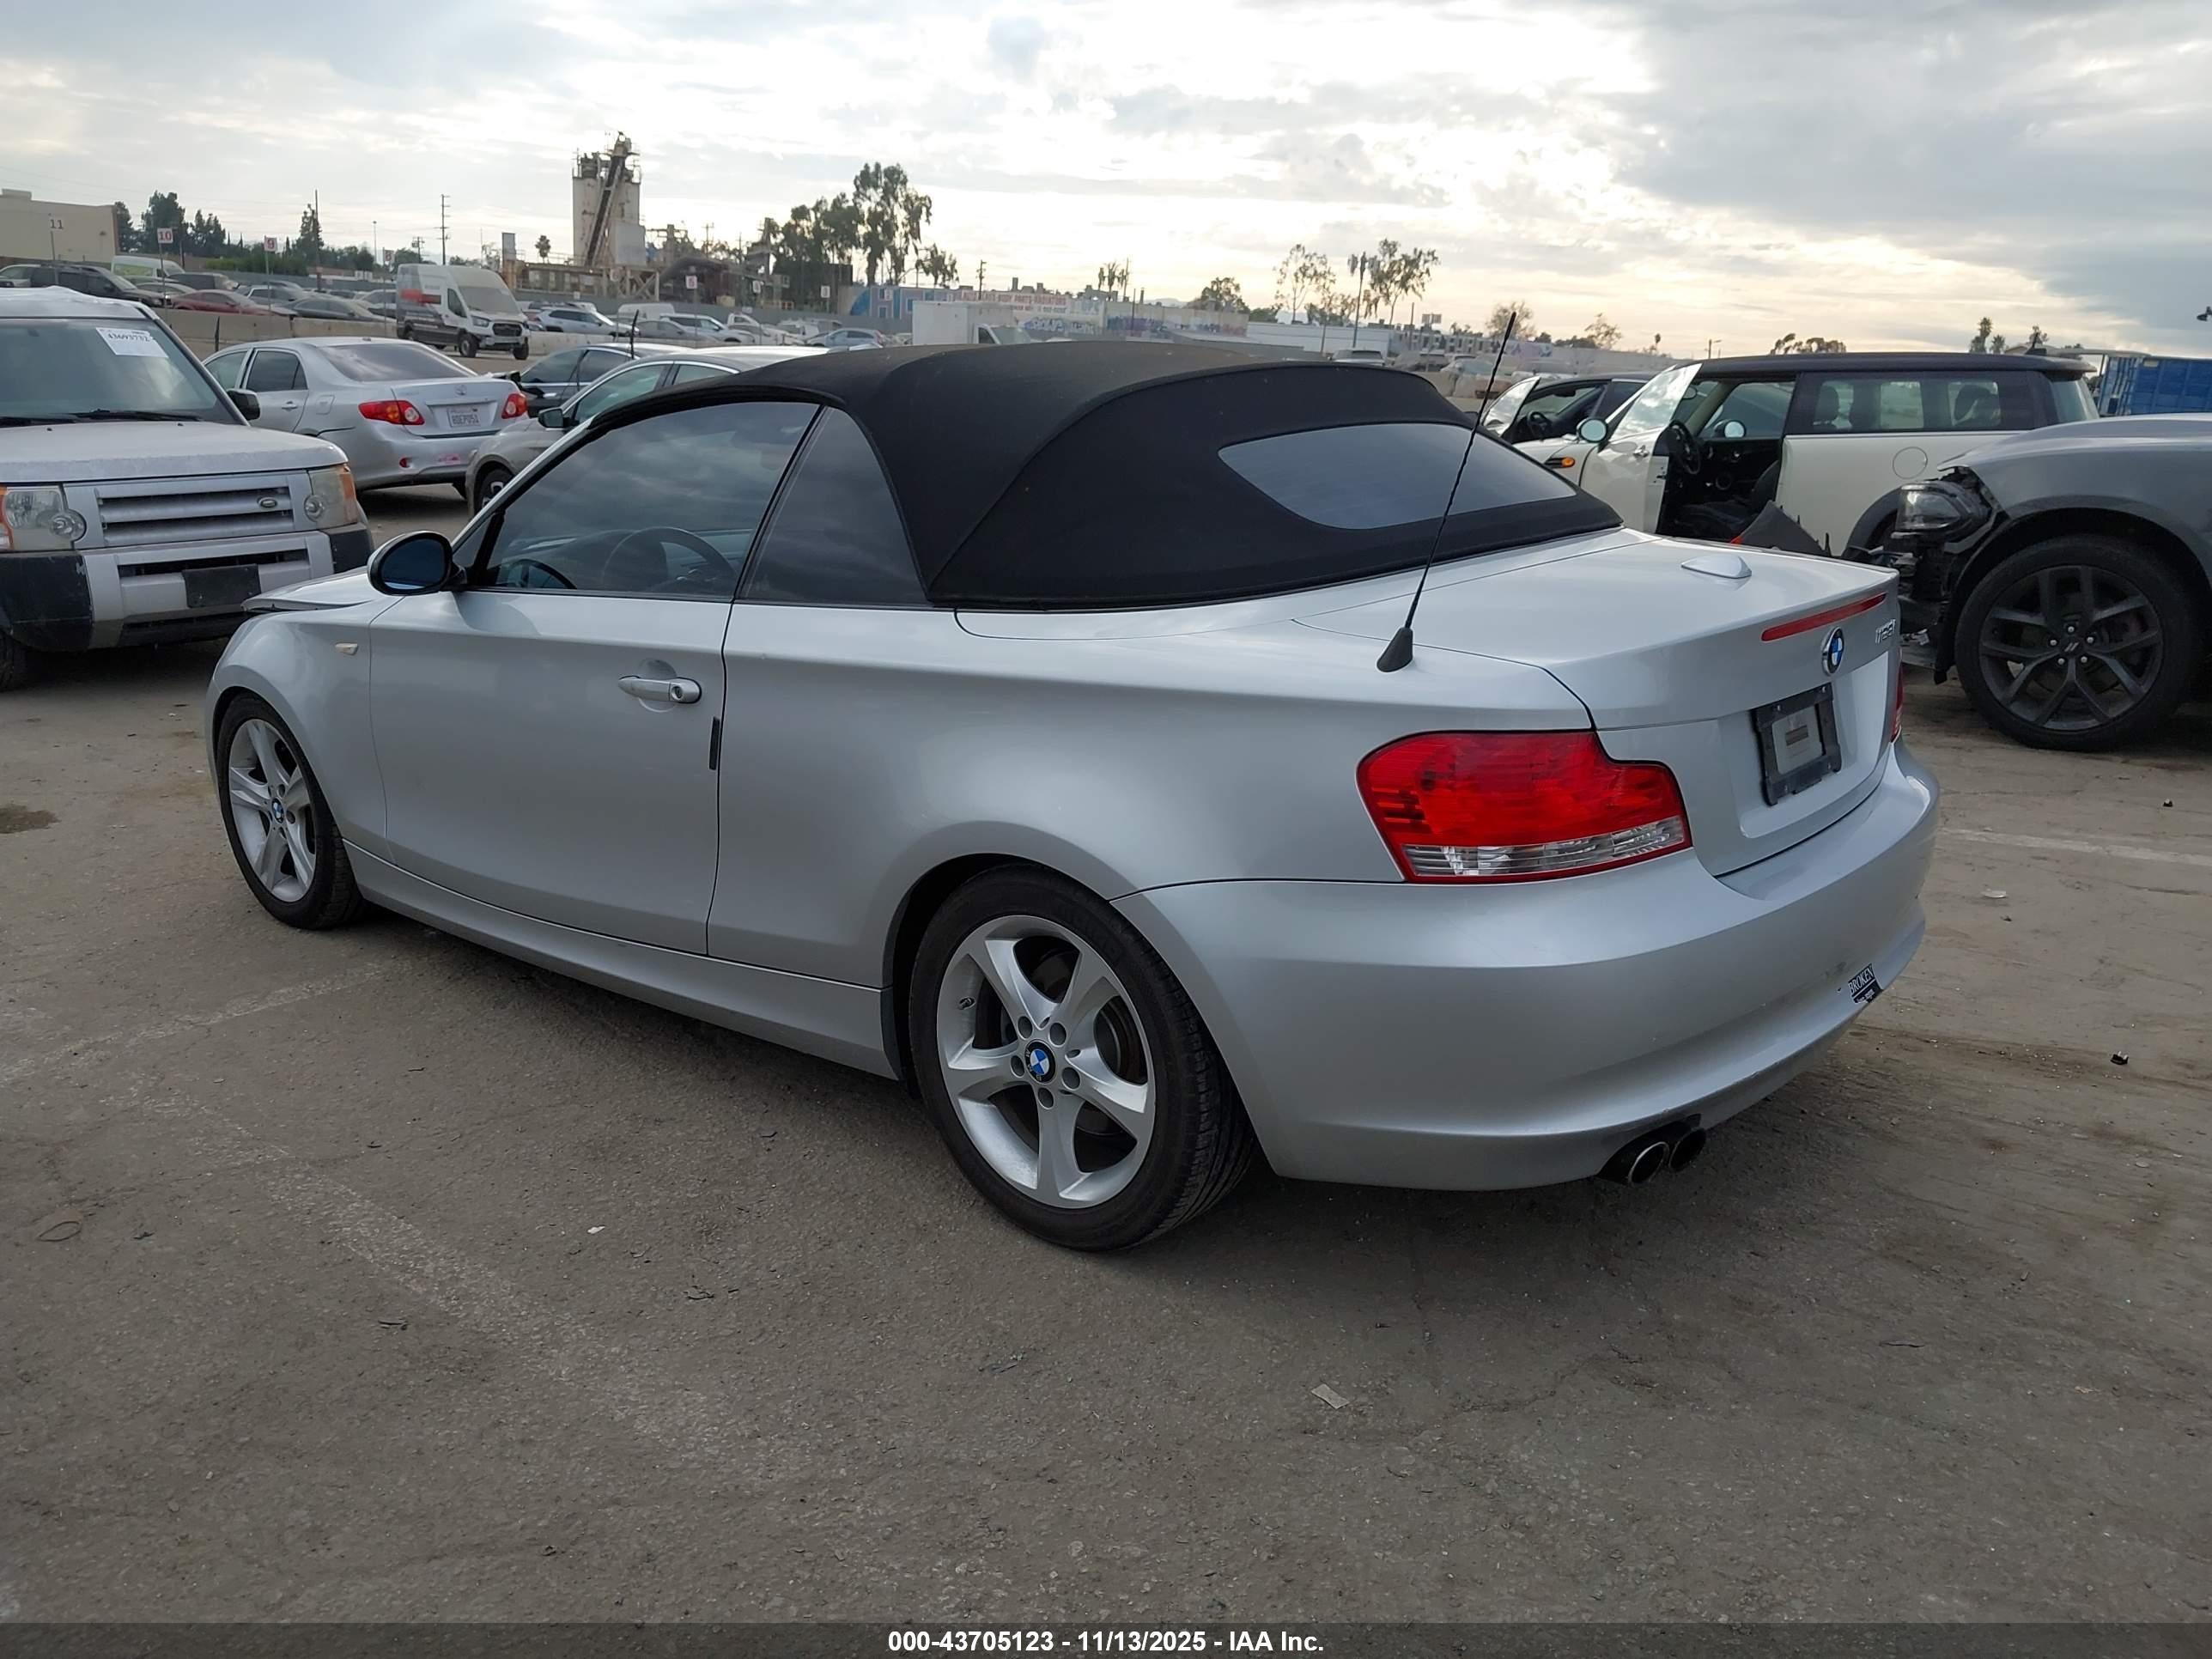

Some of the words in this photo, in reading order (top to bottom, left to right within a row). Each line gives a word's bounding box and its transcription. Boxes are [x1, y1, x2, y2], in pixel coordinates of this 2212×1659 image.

[50, 219, 64, 229] 11
[159, 231, 172, 240] 10
[267, 240, 275, 249] 9
